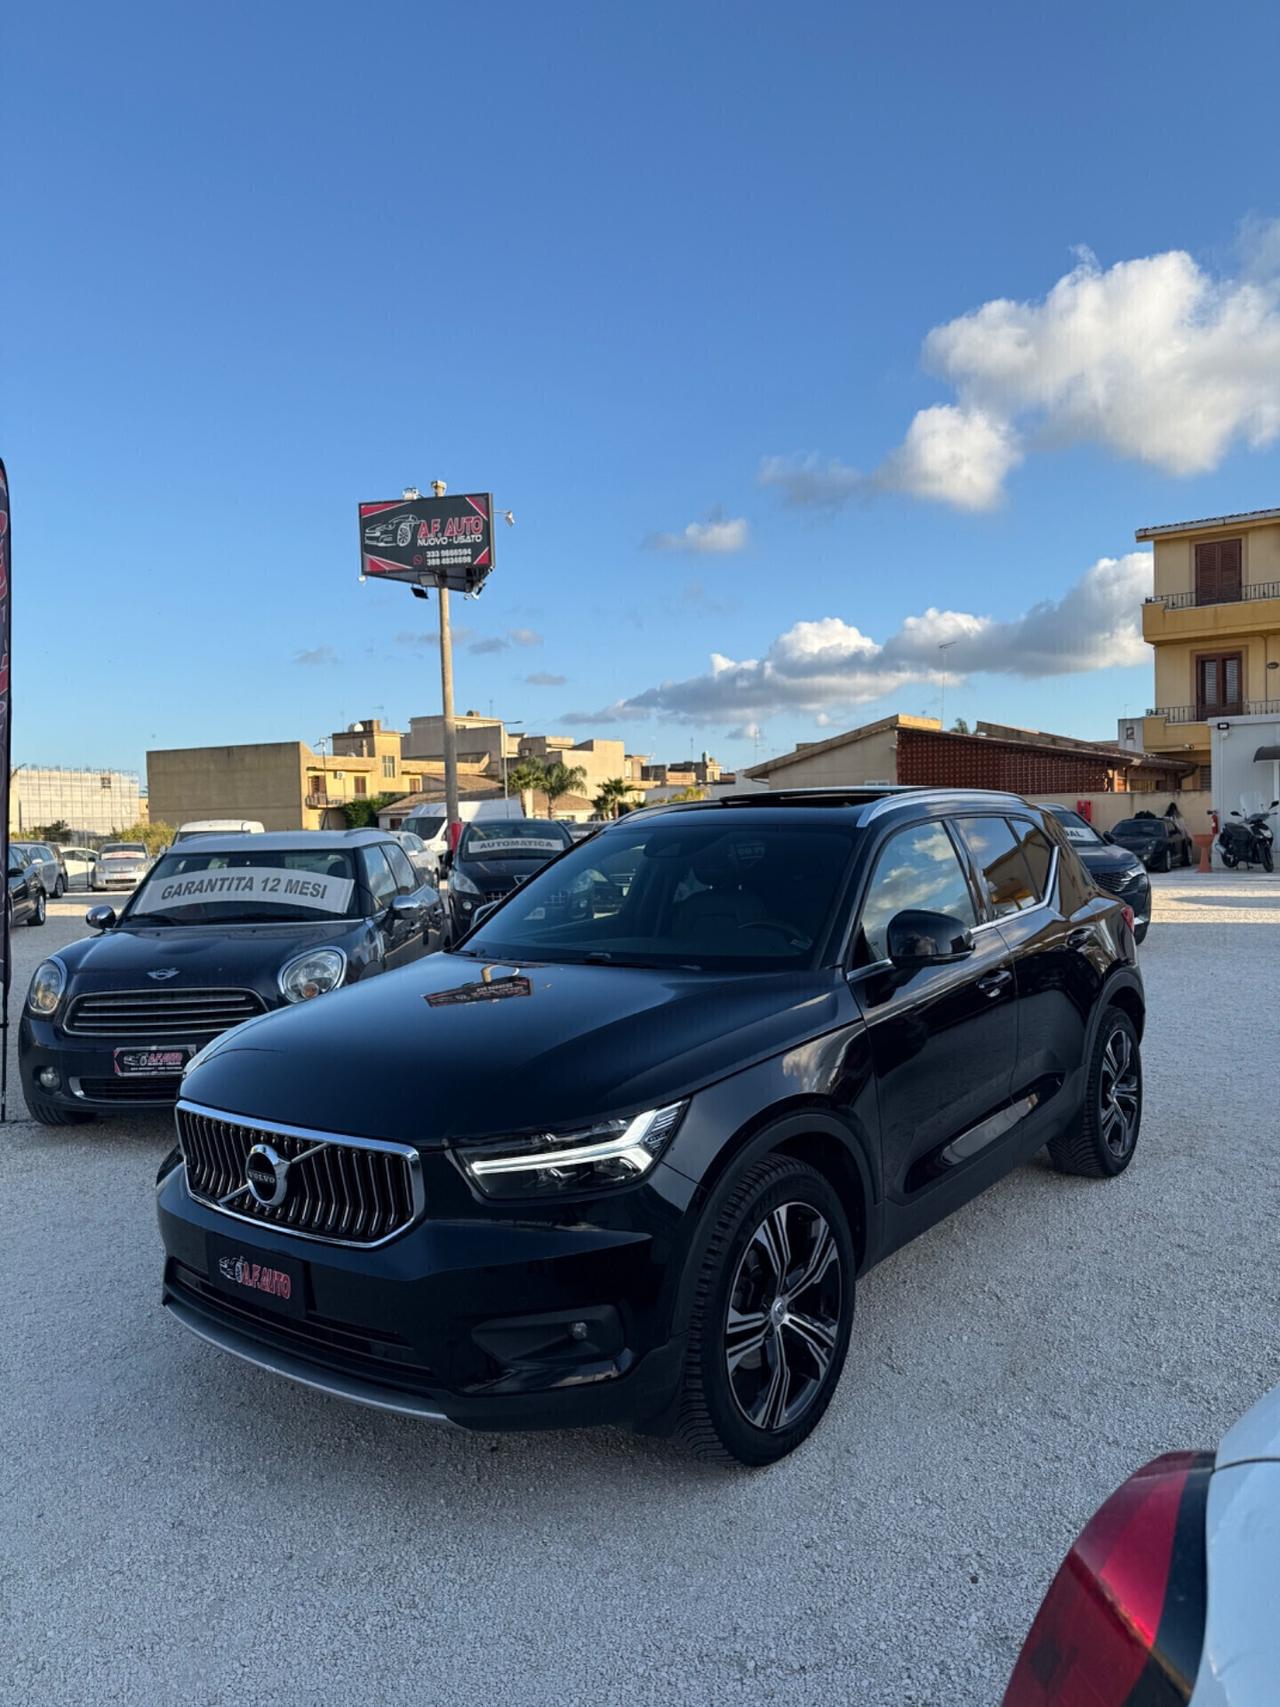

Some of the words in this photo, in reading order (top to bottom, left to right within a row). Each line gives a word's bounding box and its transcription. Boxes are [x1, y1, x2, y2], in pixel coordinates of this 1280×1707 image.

[444, 515, 483, 536] AUTO
[480, 839, 553, 849] AUTOMATICA
[161, 876, 254, 900] GARANTITA
[261, 876, 279, 893] 12
[284, 878, 328, 899] MESI
[247, 1170, 275, 1184] VOLVO
